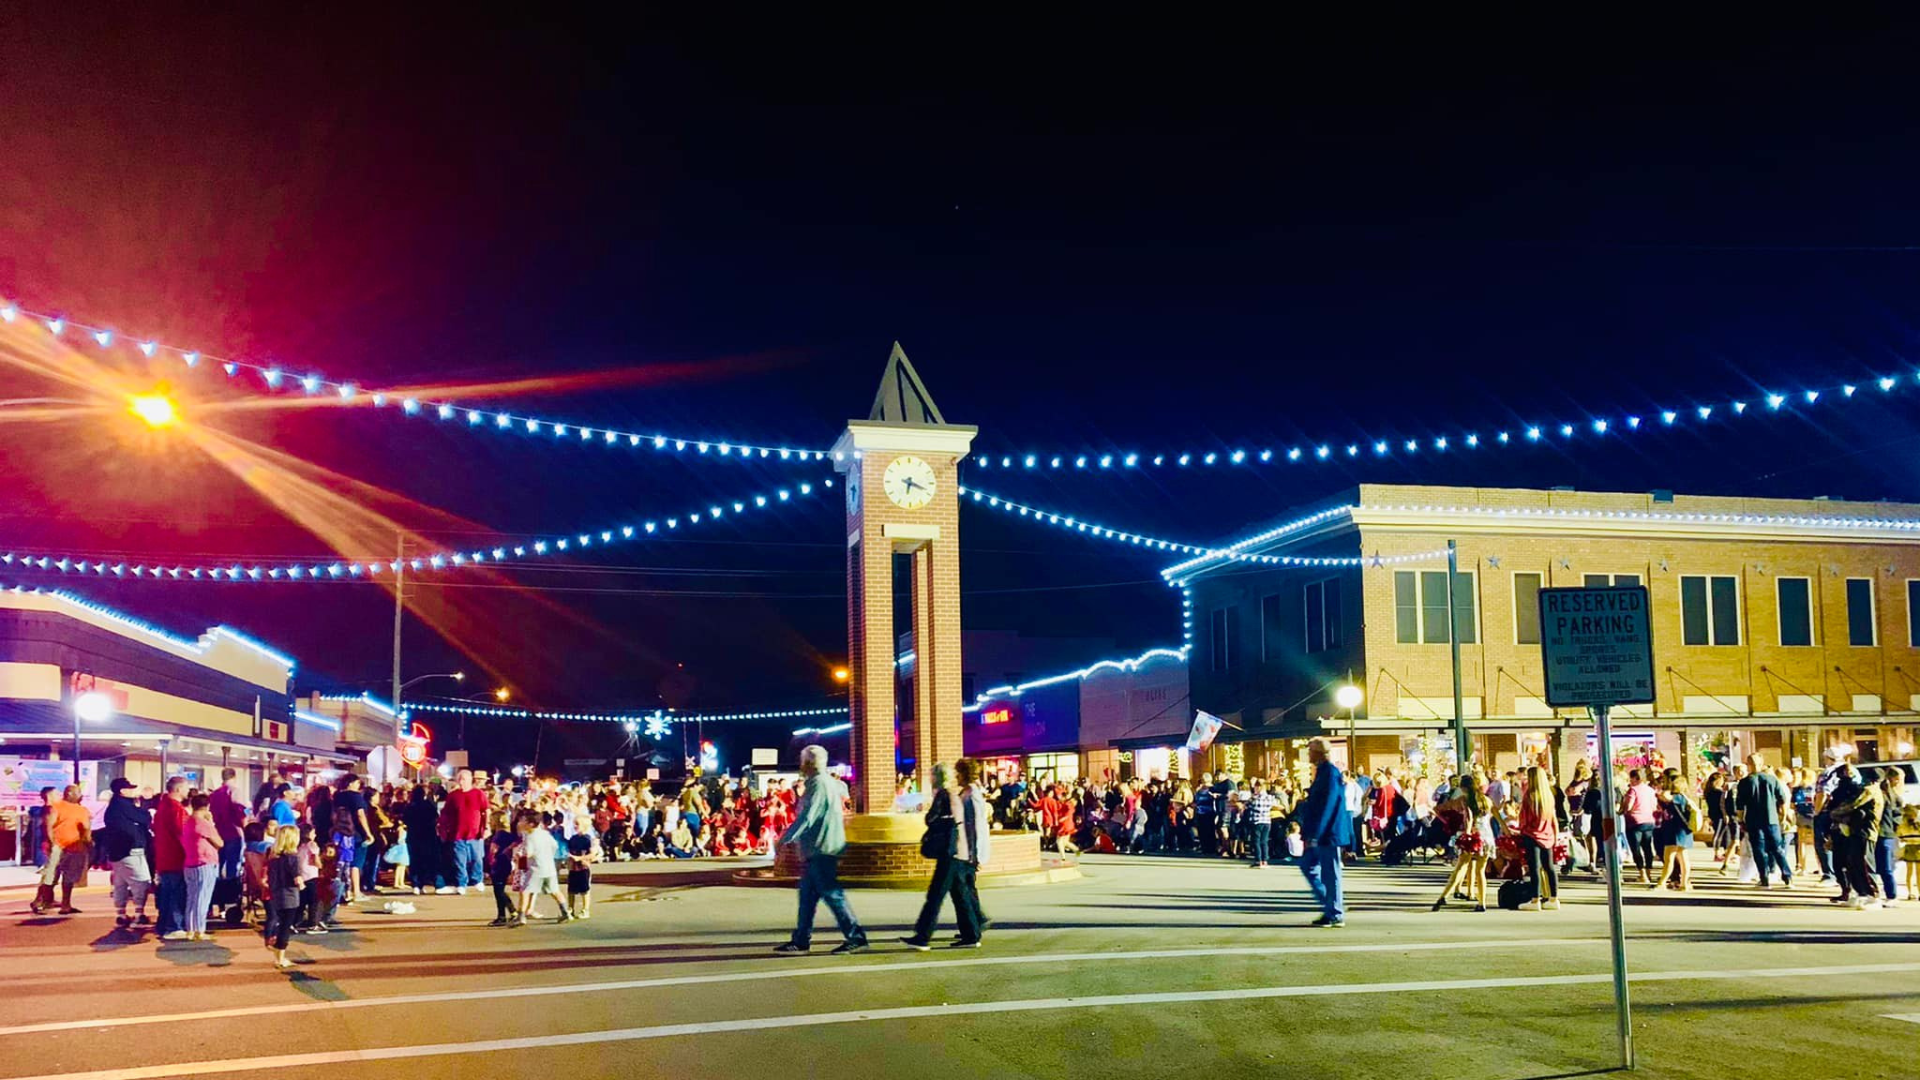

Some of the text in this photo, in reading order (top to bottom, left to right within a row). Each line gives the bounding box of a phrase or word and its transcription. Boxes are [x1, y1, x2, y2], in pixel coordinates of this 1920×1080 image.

[1547, 592, 1640, 613] RESERVED
[1557, 615, 1634, 634] PARKING
[1596, 653, 1642, 663] VEHICLES
[1578, 665, 1621, 673] ALLOWED
[1553, 679, 1648, 691] VIOLATORS WILL BE
